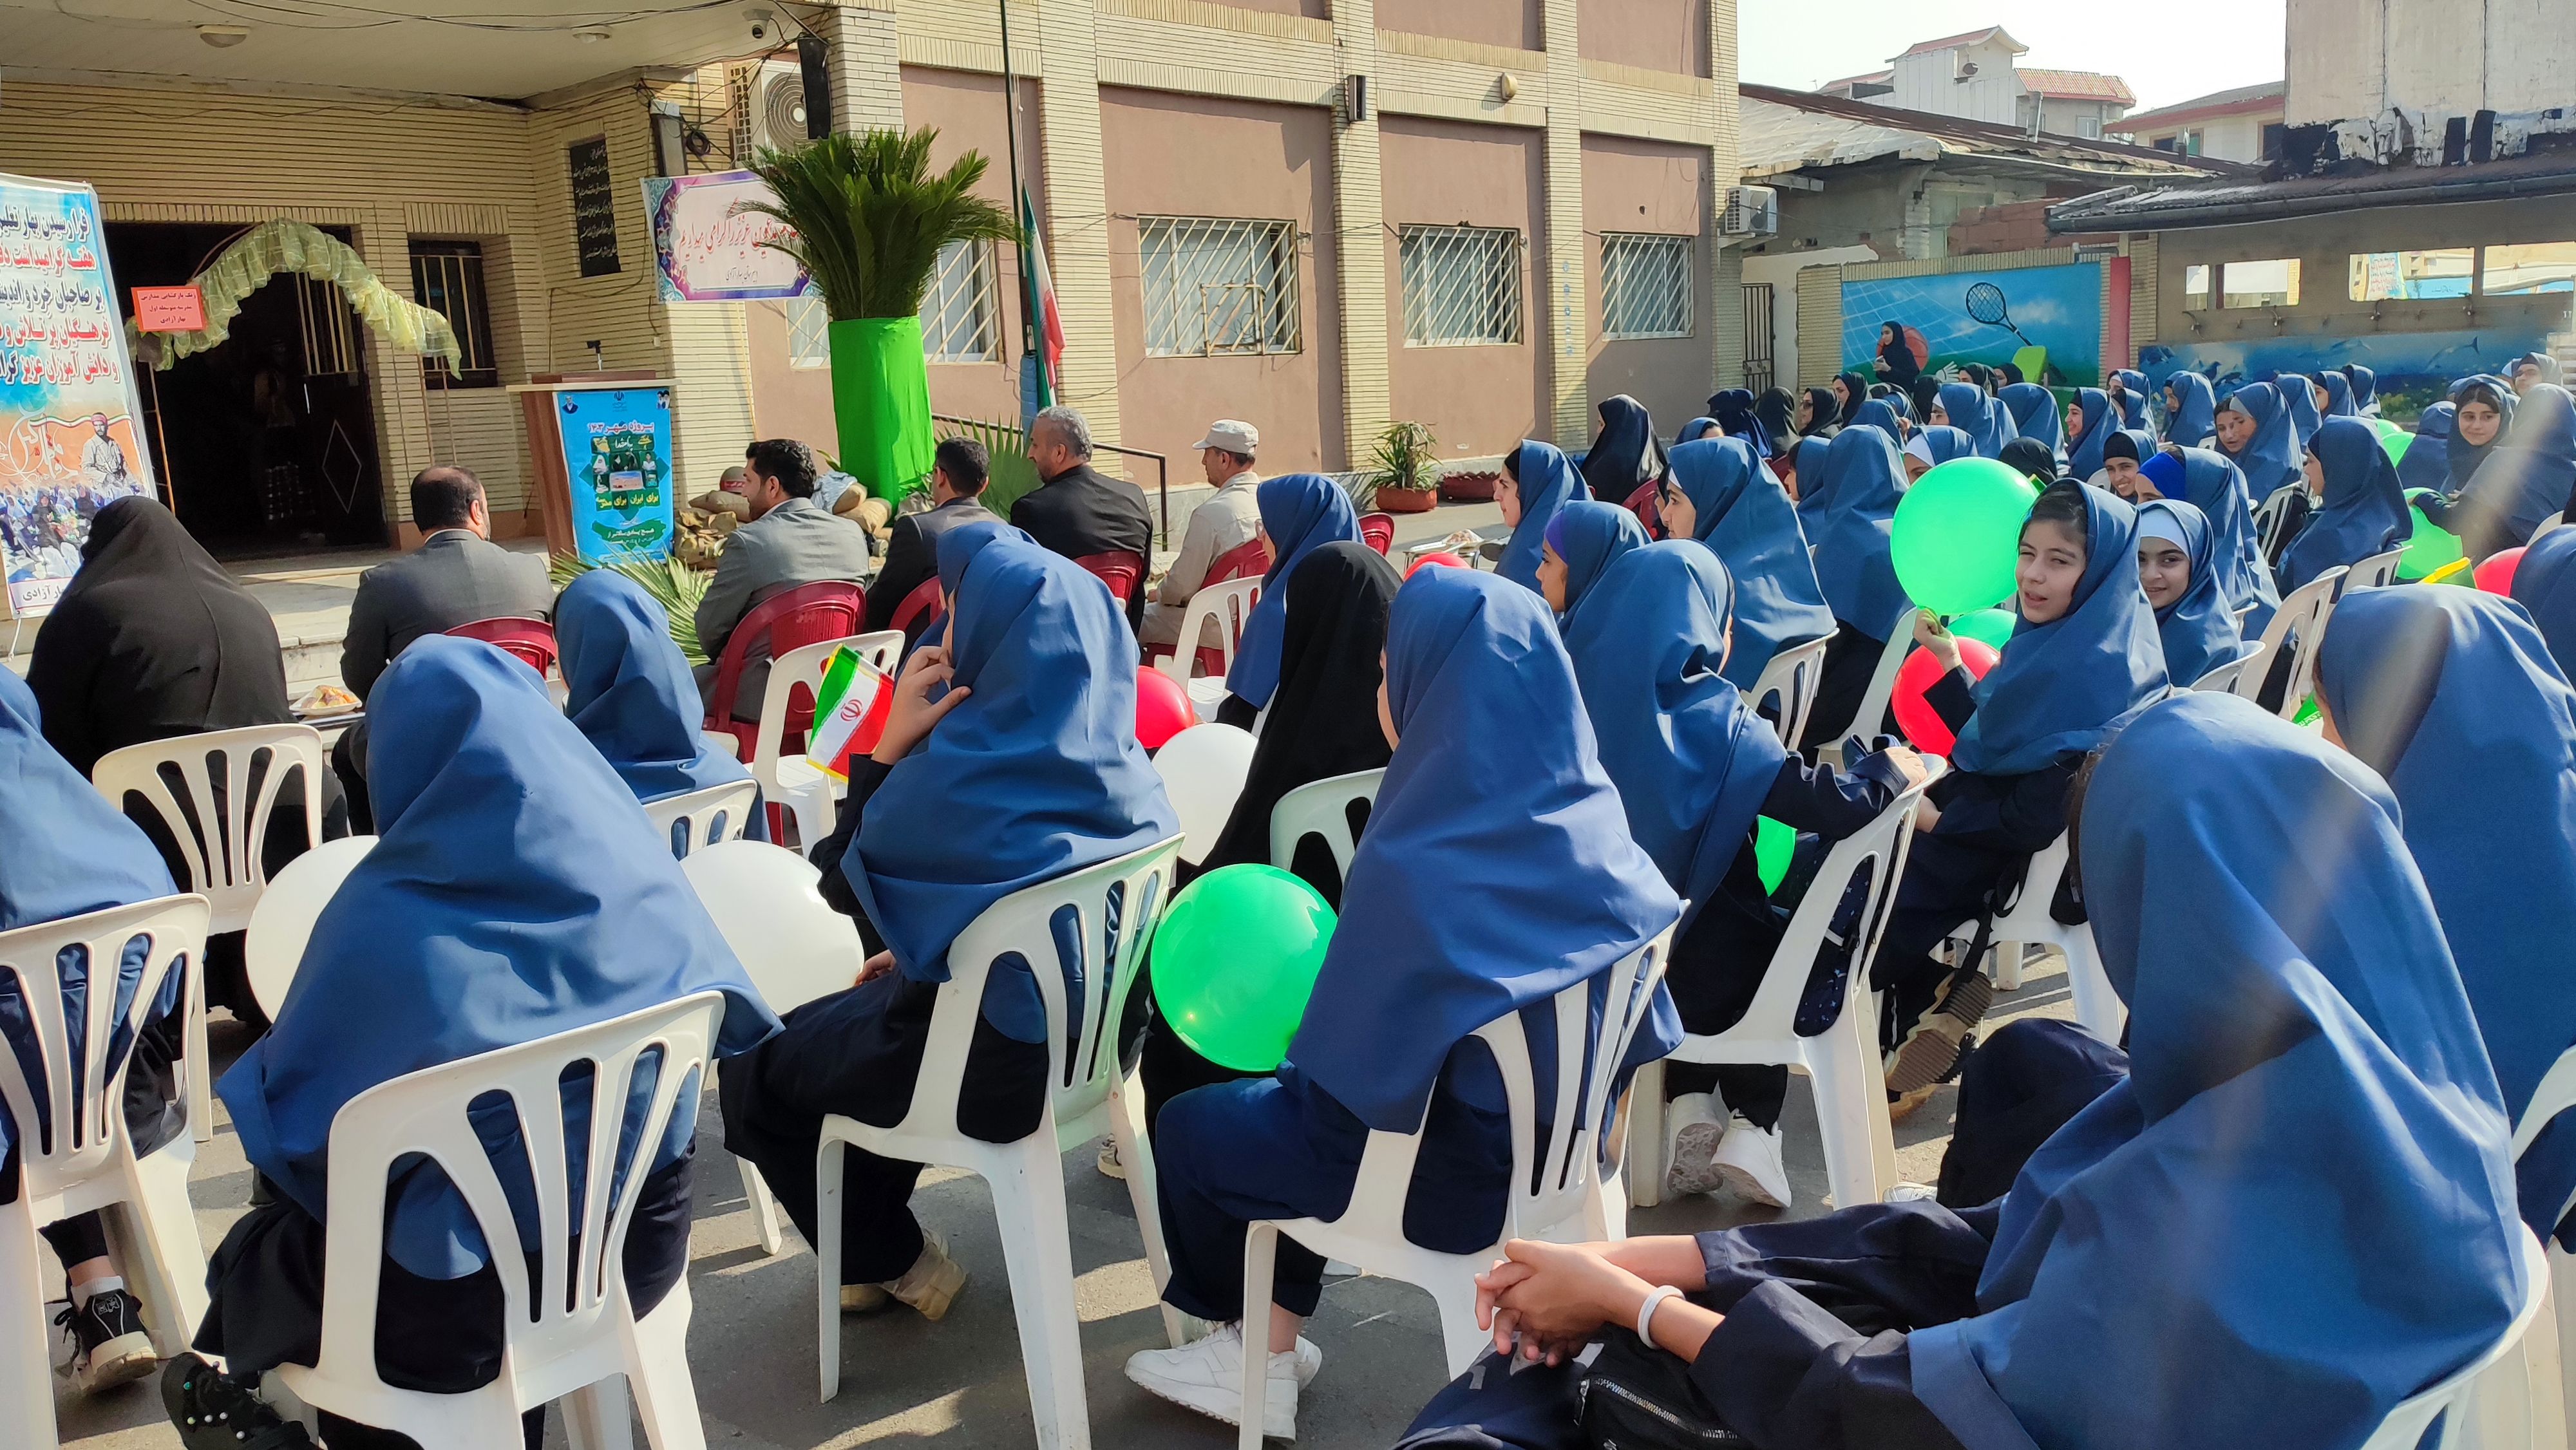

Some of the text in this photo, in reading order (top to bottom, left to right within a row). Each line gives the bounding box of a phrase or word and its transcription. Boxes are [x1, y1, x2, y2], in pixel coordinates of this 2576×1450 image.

[23, 205, 39, 237] بهار
[706, 197, 738, 253] گرامی
[735, 214, 751, 258] عزیز
[14, 243, 64, 275] گرامیداشت
[67, 245, 97, 269] هفته
[25, 288, 33, 310] و
[56, 280, 90, 312] صاحبان
[95, 287, 104, 312] بر
[15, 314, 46, 346] تلاش
[60, 316, 111, 348] فرهنگیان
[160, 315, 176, 324] آزادی
[50, 323, 60, 349] پر
[21, 356, 44, 384] عزیز
[46, 350, 80, 383] آموزان
[84, 352, 110, 382] دانش
[111, 360, 120, 382] و
[605, 425, 627, 435] مهر
[629, 420, 654, 433] پروژه
[614, 495, 627, 506] برای
[630, 494, 643, 505] ایران
[646, 493, 659, 503] برای
[23, 585, 51, 601] آزادی
